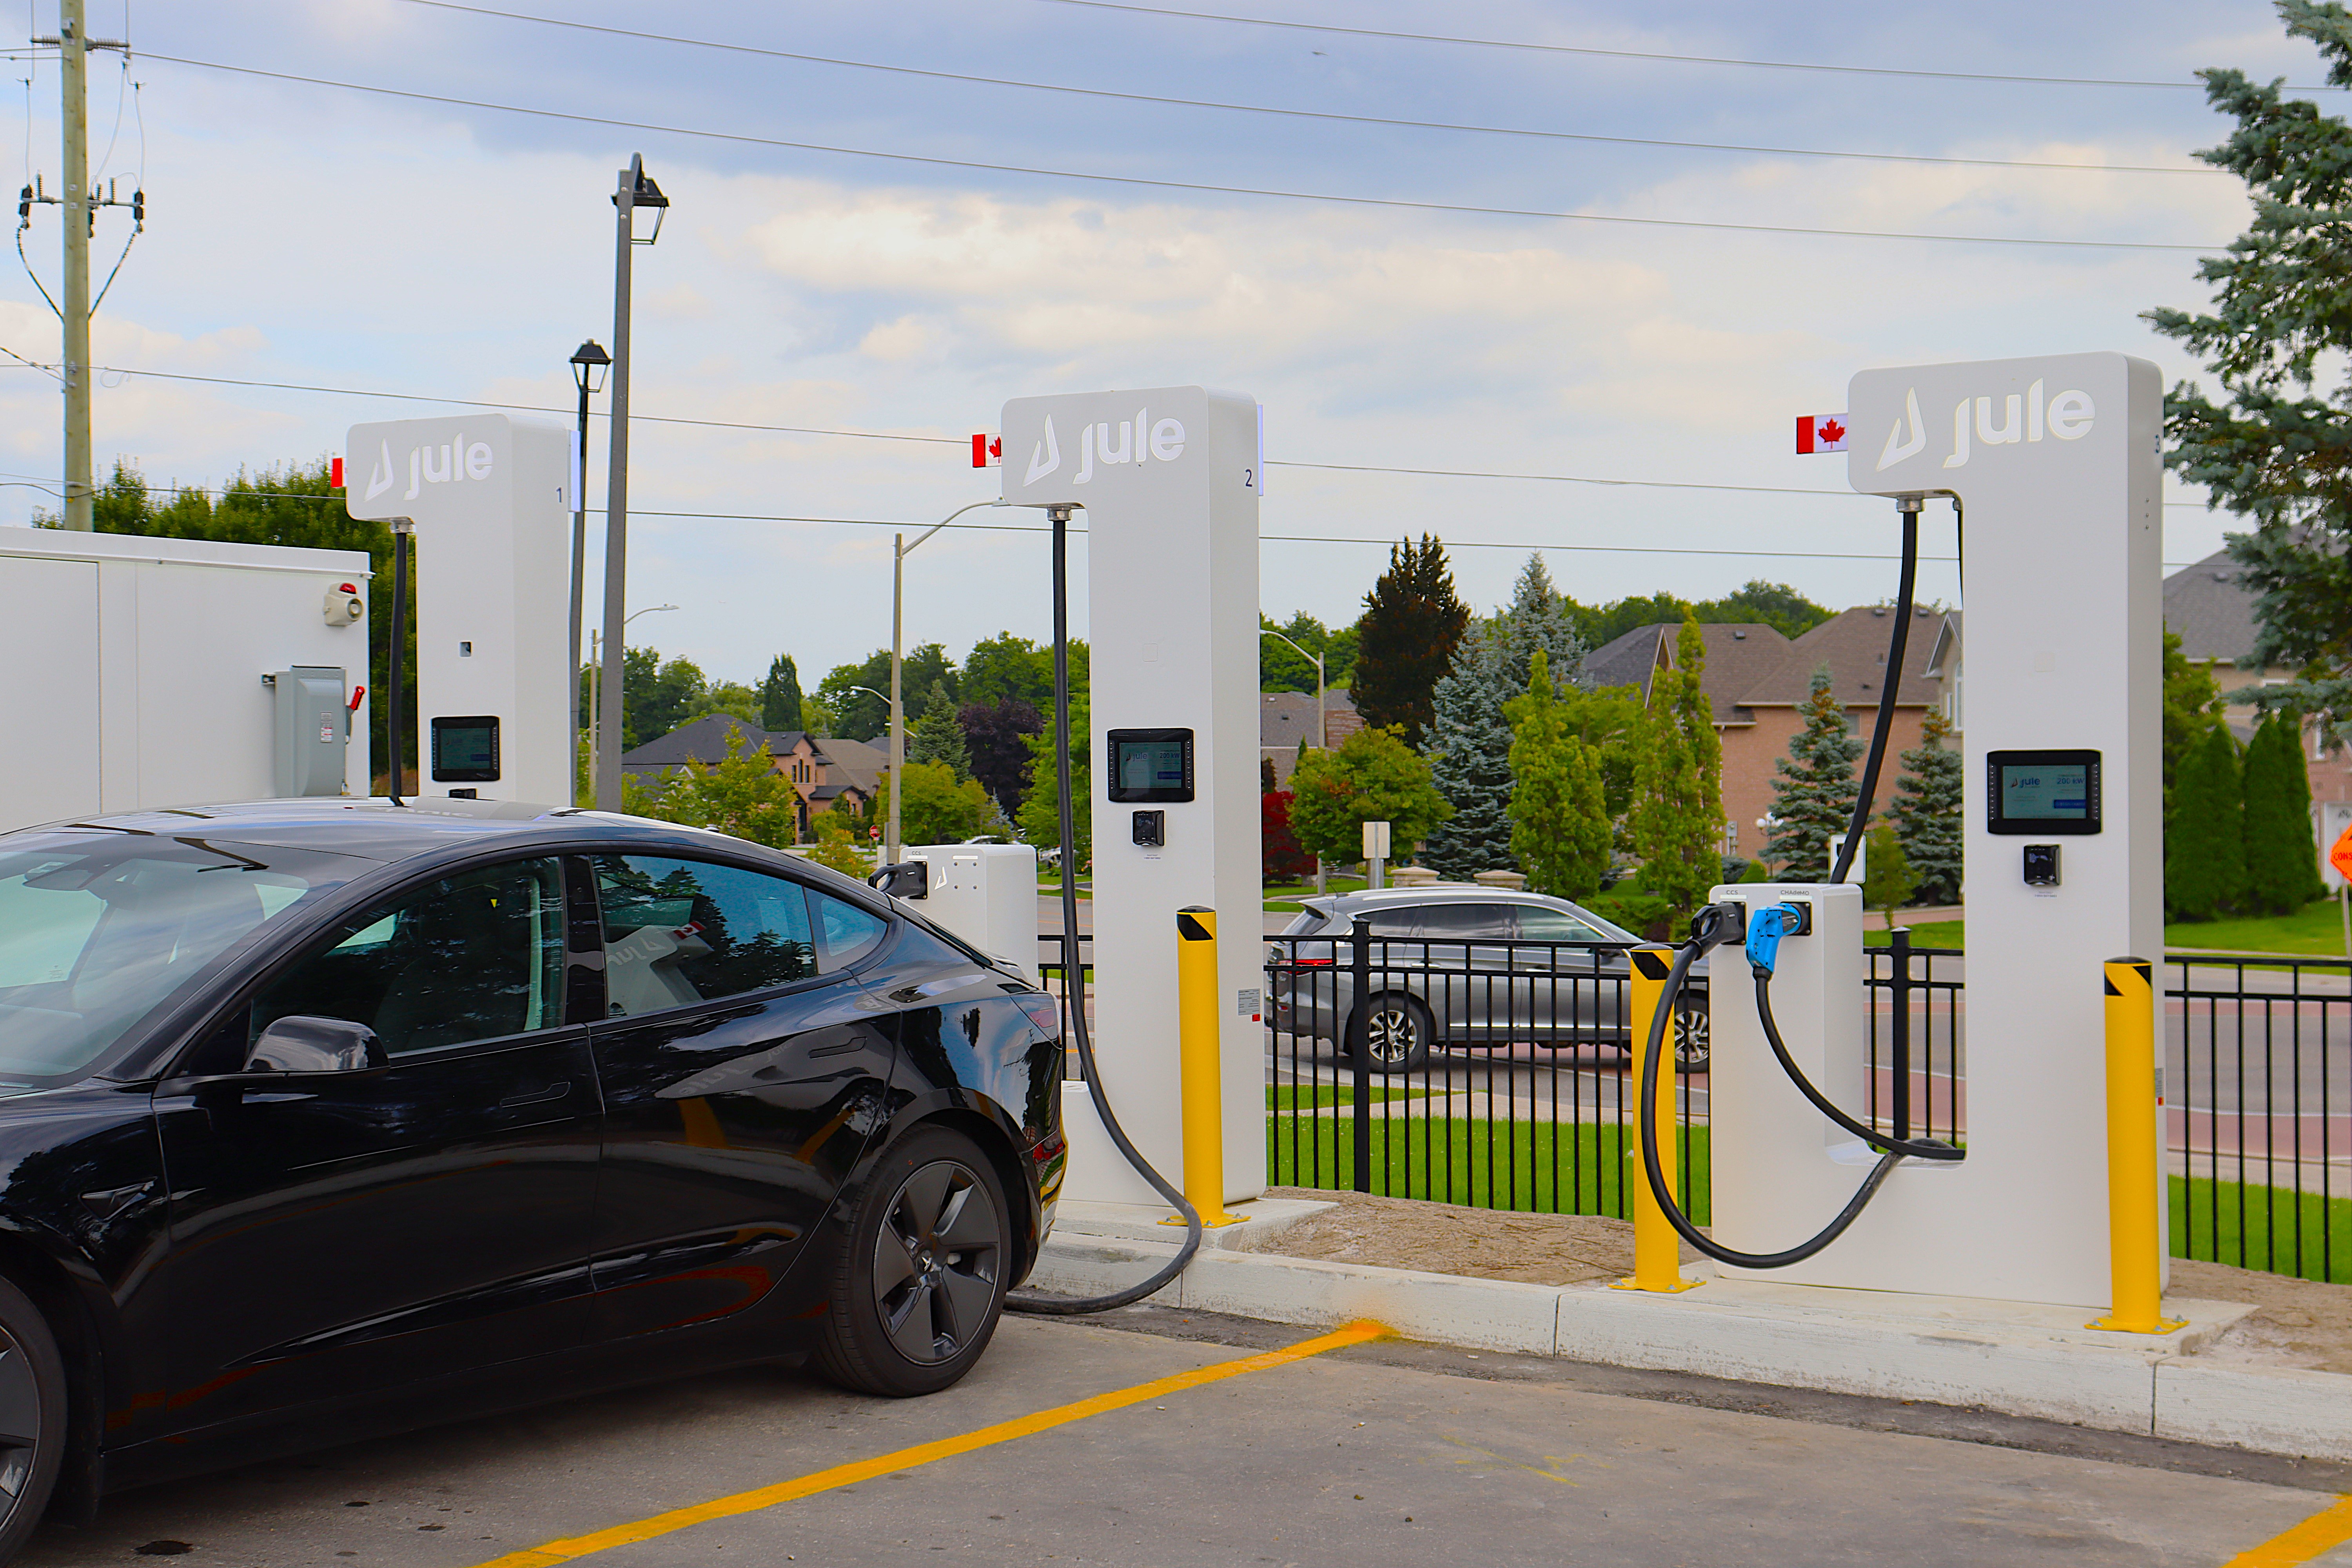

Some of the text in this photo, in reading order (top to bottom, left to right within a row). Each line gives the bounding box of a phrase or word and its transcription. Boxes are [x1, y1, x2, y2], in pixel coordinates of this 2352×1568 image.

[1943, 377, 2096, 468] jule
[2155, 434, 2161, 453] 3
[403, 432, 492, 500] jule
[1073, 407, 1185, 484] jule
[556, 487, 561, 503] 1
[1245, 468, 1252, 487] 2
